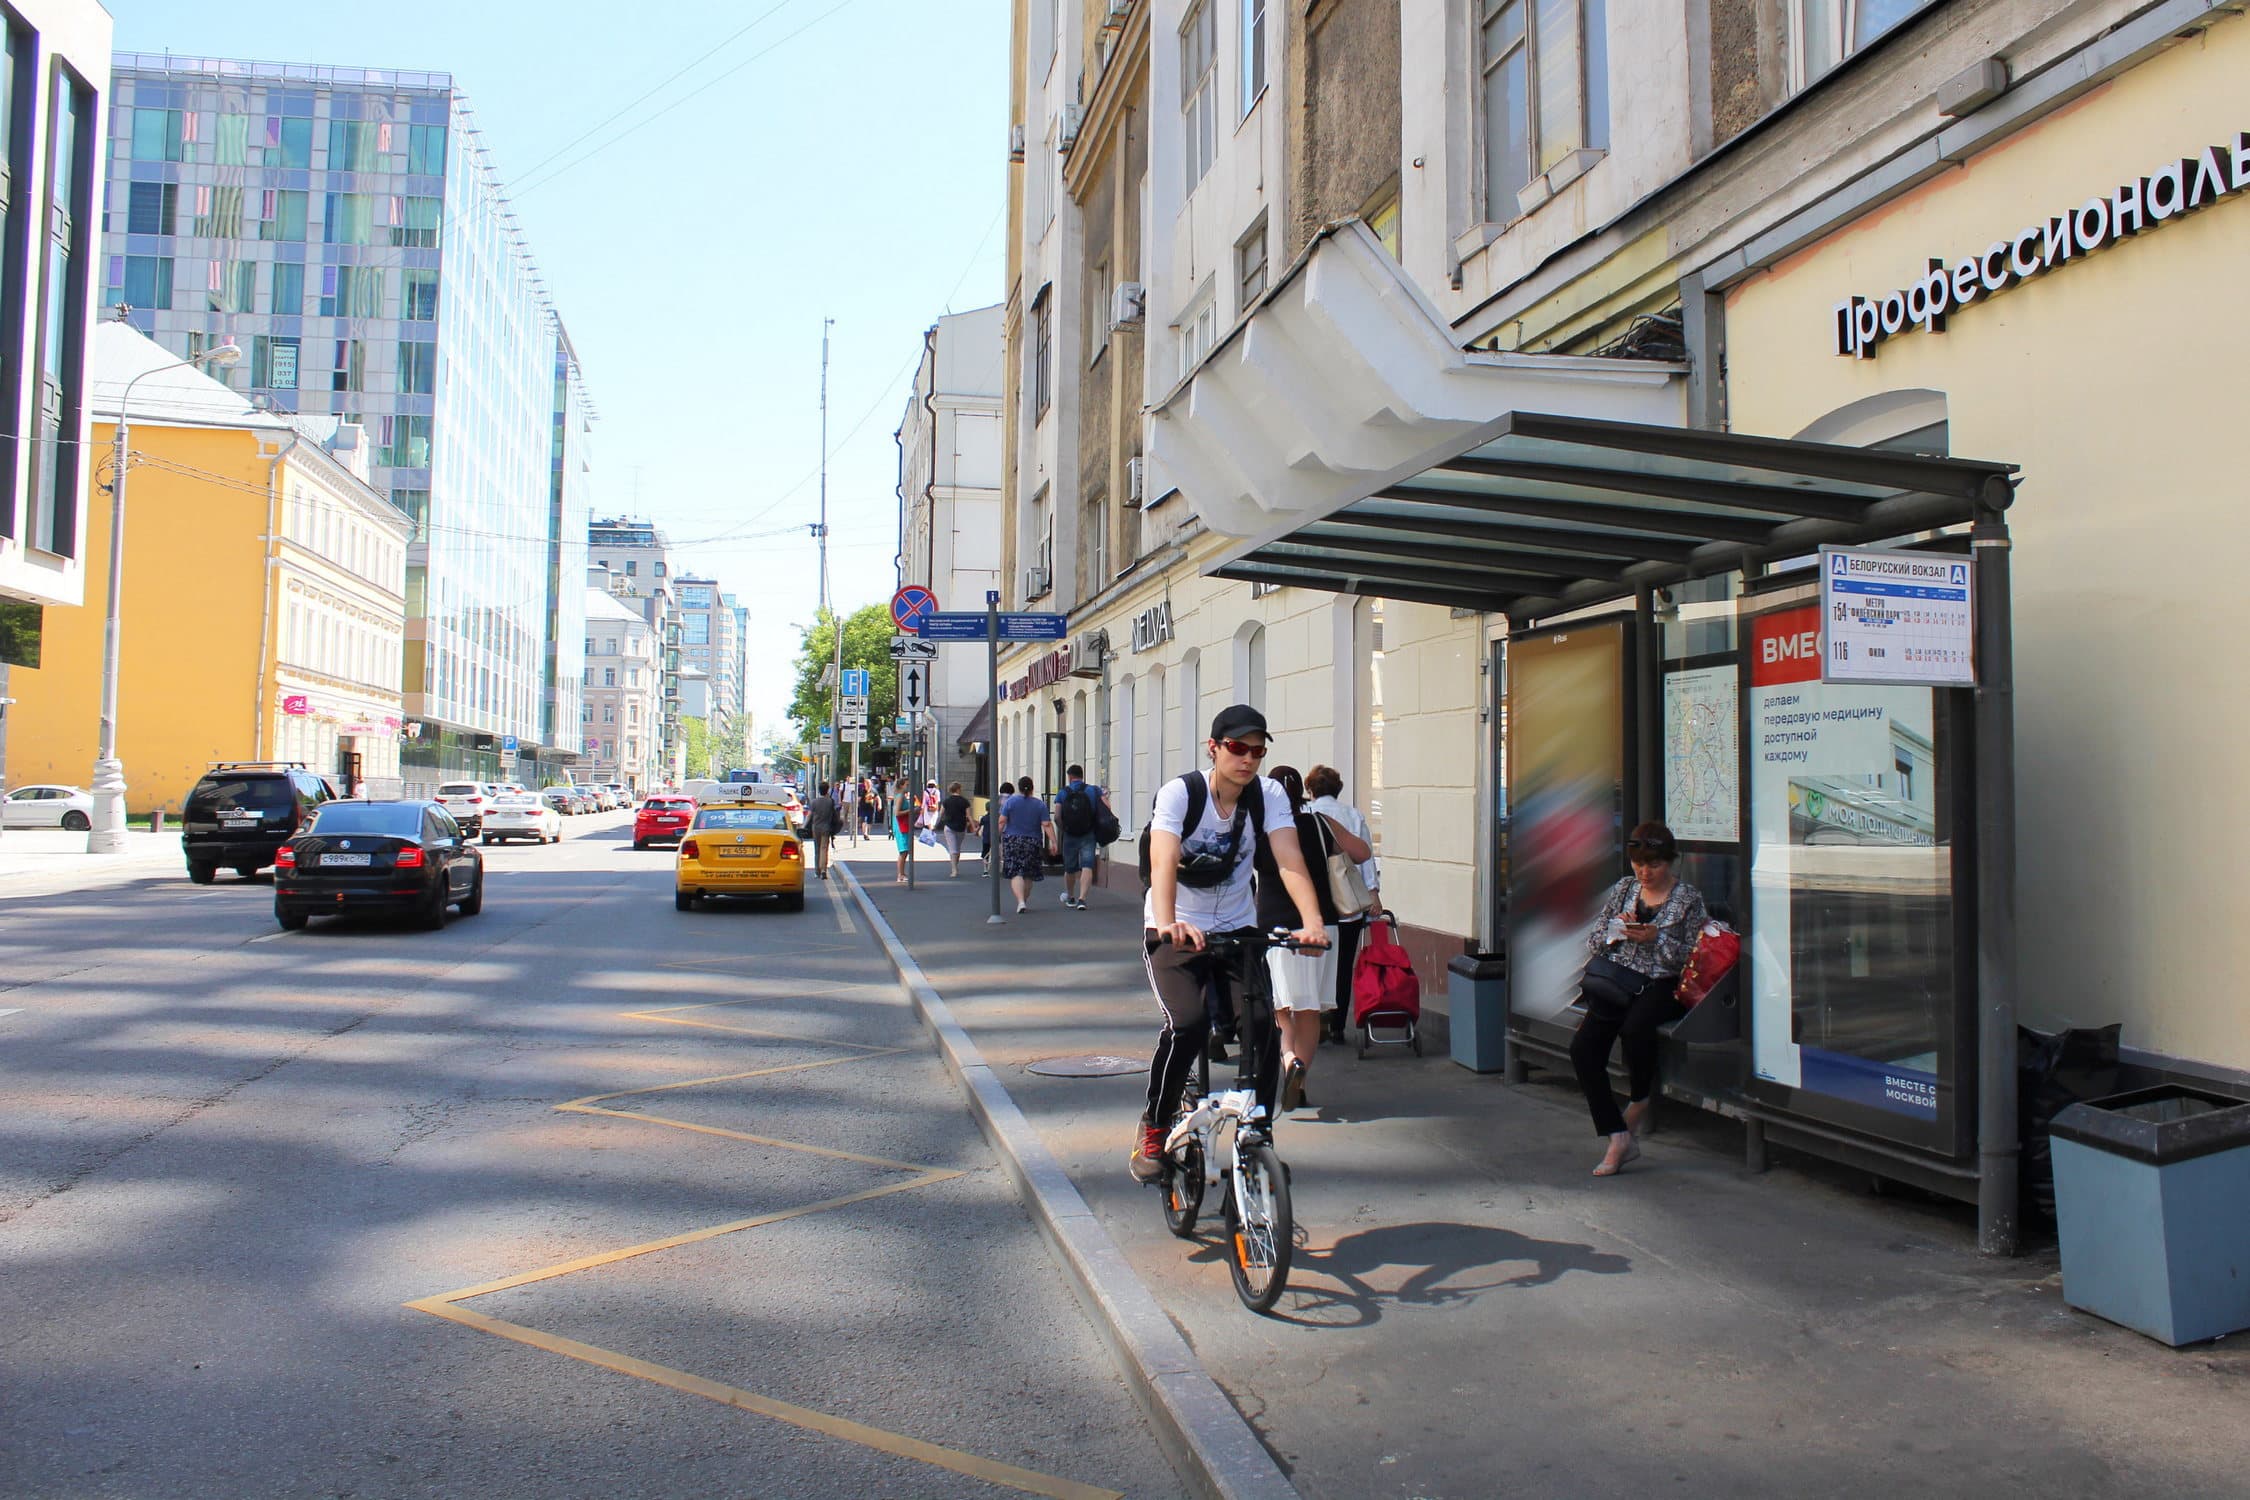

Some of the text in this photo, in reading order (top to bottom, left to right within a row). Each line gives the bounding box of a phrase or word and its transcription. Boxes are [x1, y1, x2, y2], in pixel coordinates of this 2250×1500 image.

[1850, 559, 1910, 575] БЕЛОРУССКИЙ
[1912, 565, 1946, 577] ВОКЗАЛ
[1865, 597, 1885, 608] МЕТРО
[1132, 600, 1172, 653] NELVA
[1833, 641, 1848, 660] 116
[1764, 695, 1800, 709] делаем
[1764, 706, 1883, 727] передовую медицину
[506, 738, 515, 749] P
[1764, 728, 1817, 745] доступной
[1764, 750, 1808, 763] каждому
[1827, 803, 1856, 827] МОЯ
[1885, 1075, 1936, 1095] ВМЕСТЕ С
[1886, 1088, 1936, 1109] МОСКВОЙ
